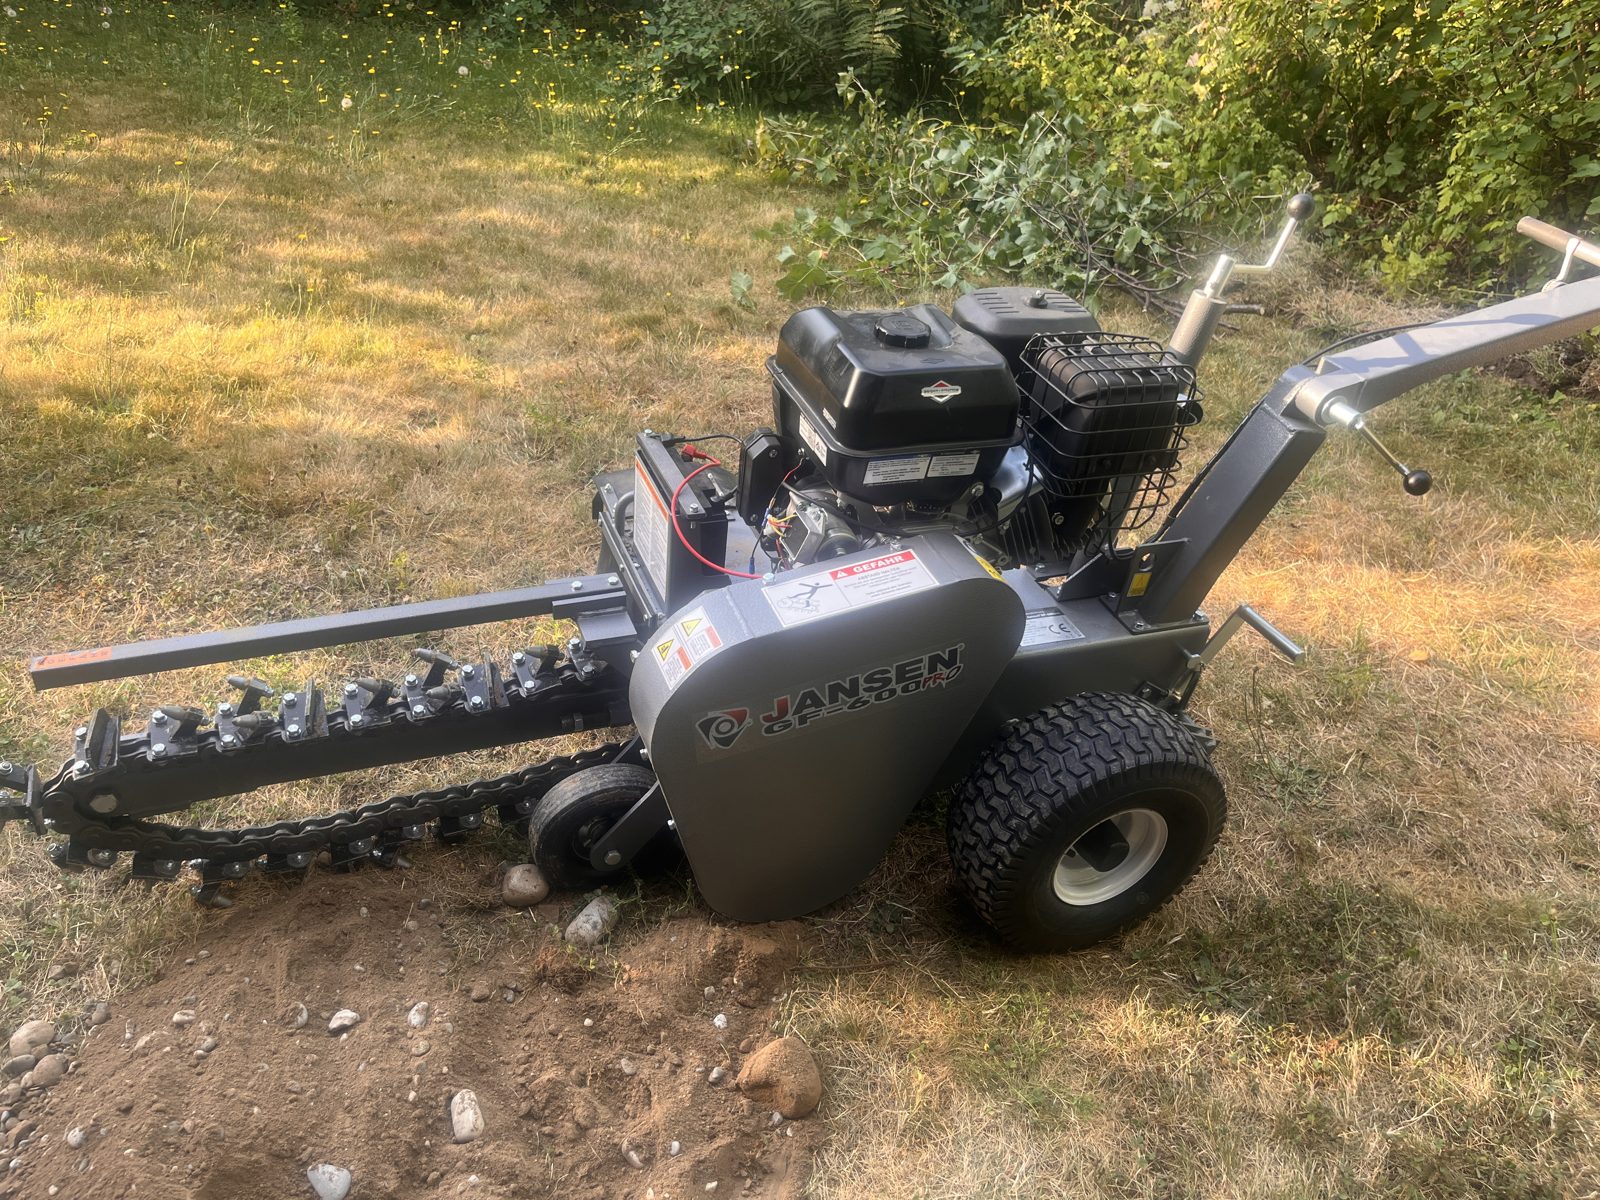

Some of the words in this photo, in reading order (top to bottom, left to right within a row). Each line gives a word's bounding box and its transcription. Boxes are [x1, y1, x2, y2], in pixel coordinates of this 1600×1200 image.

[853, 556, 904, 573] GEFAHR
[761, 647, 960, 723] JANSEN
[762, 679, 922, 736] GF-600
